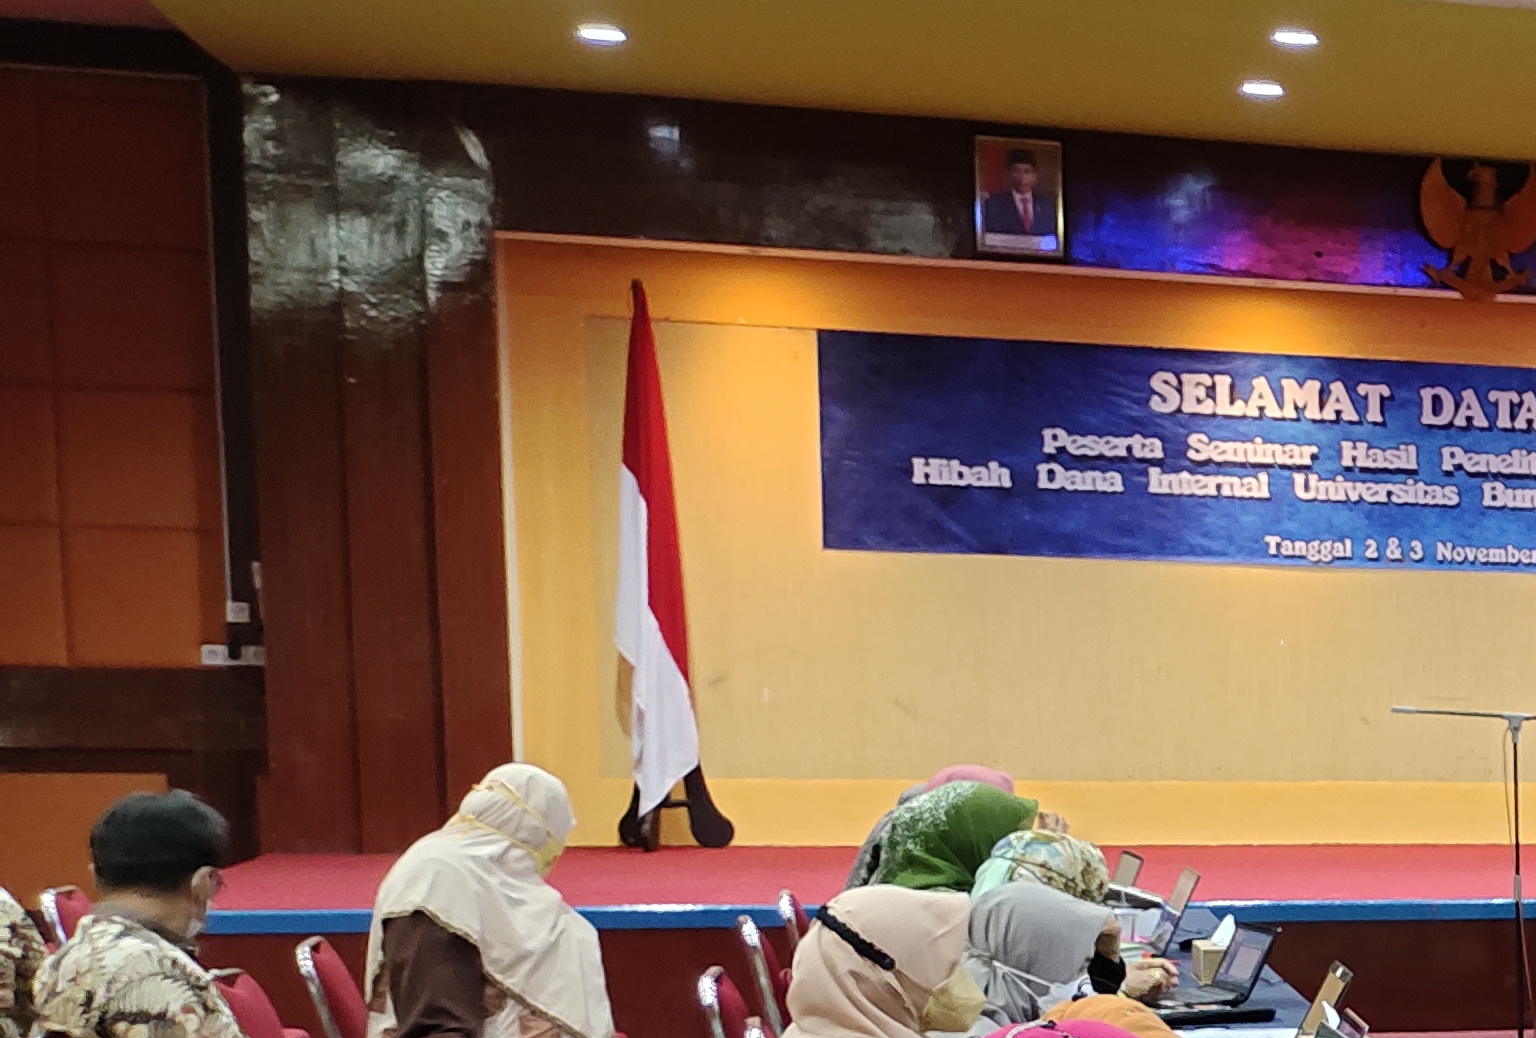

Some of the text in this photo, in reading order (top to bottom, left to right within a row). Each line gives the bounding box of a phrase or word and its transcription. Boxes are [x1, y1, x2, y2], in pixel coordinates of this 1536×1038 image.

[1148, 371, 1391, 425] SELAMAT
[1041, 427, 1165, 460] Peserta
[1186, 433, 1318, 468] Seminar
[1339, 440, 1419, 470] Hasil
[911, 457, 1013, 488] Hibah
[1036, 462, 1125, 492] Dana
[1147, 466, 1271, 498] Internal
[1292, 472, 1461, 506] Universitas
[1264, 534, 1353, 564] Tanggal
[1364, 538, 1379, 559] 2
[1385, 538, 1403, 560] &
[1409, 539, 1424, 561] 3
